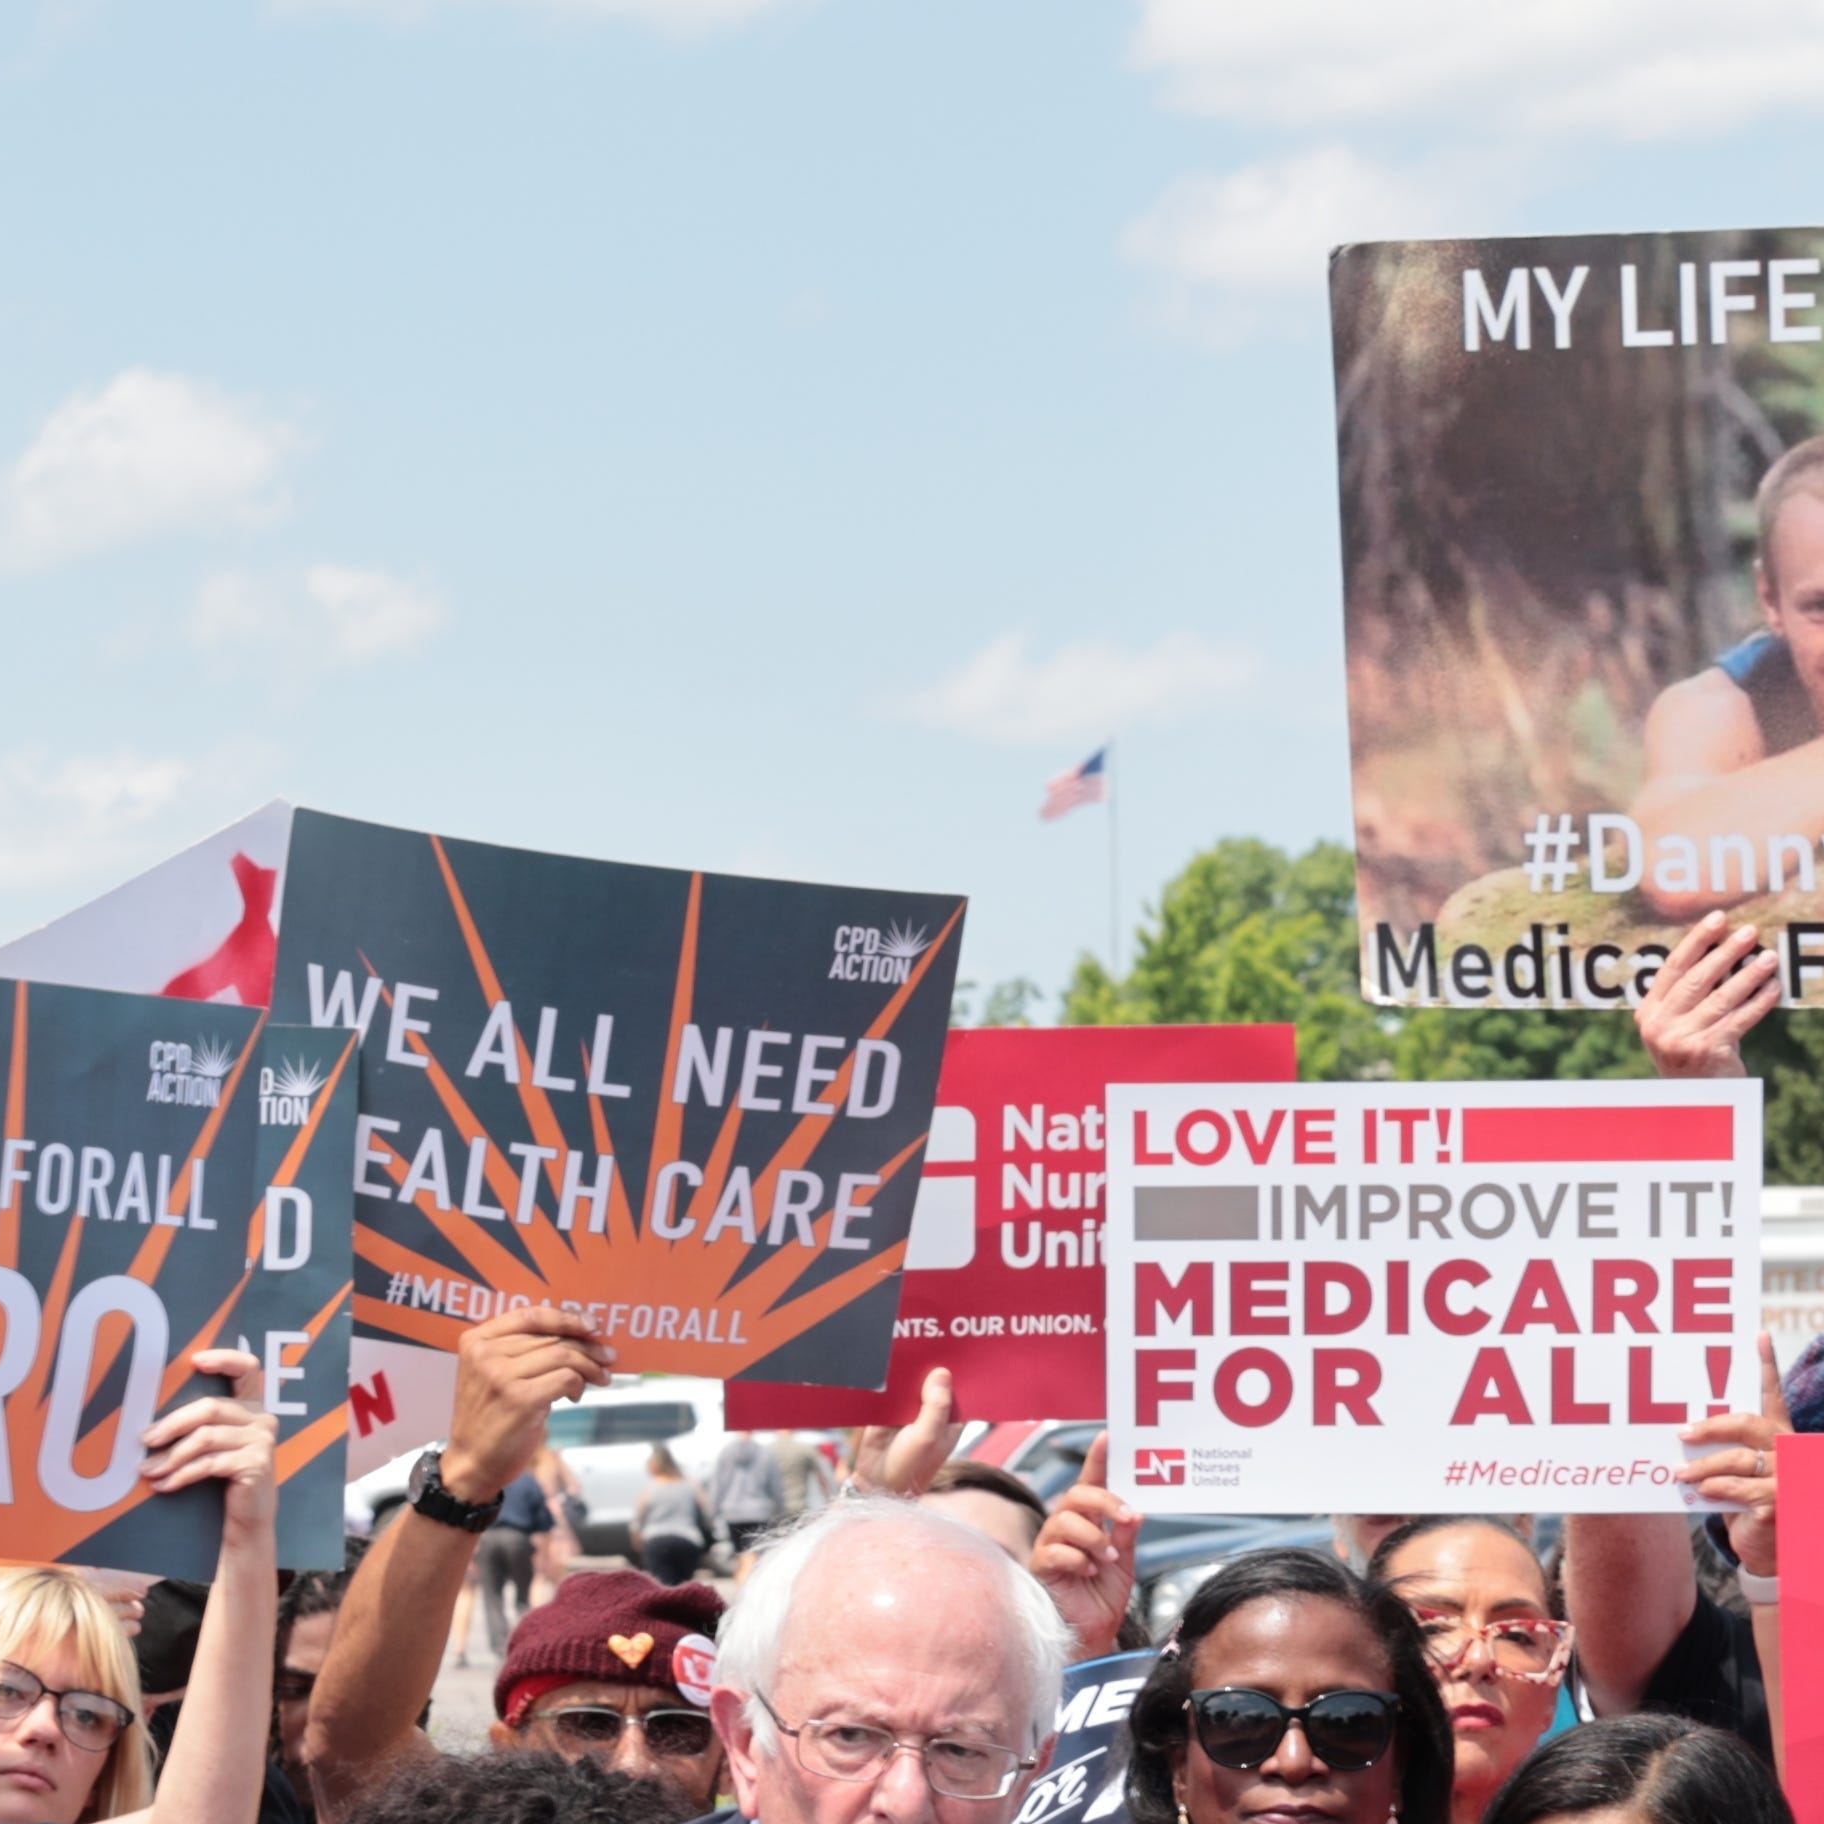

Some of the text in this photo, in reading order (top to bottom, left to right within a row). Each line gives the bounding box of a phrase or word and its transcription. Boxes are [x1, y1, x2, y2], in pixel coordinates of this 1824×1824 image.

[1461, 266, 1589, 352] MY
[1620, 259, 1823, 348] LIFE
[834, 925, 881, 955] CPD
[828, 954, 912, 985] ACTION
[149, 1040, 192, 1072] CPD
[307, 963, 902, 1119] WE ALL NEED
[146, 1072, 221, 1107] ACTION
[259, 1097, 309, 1125] TION
[1134, 1109, 1335, 1166] LOVE
[1362, 1107, 1453, 1164] IT!
[353, 1112, 615, 1235] EALTH
[649, 1160, 882, 1250] CARE
[1271, 1182, 1734, 1242] IMPROVE IT!
[1134, 1259, 1734, 1337] MEDICARE
[950, 1316, 1005, 1337] OUR
[1011, 1314, 1097, 1336] UNION.
[1134, 1346, 1382, 1428] FOR
[1450, 1344, 1733, 1428] ALL!
[1192, 1447, 1253, 1460] National
[1192, 1462, 1241, 1473] Nurses
[1192, 1475, 1240, 1487] United
[1444, 1459, 1682, 1486] #MedicareFor
